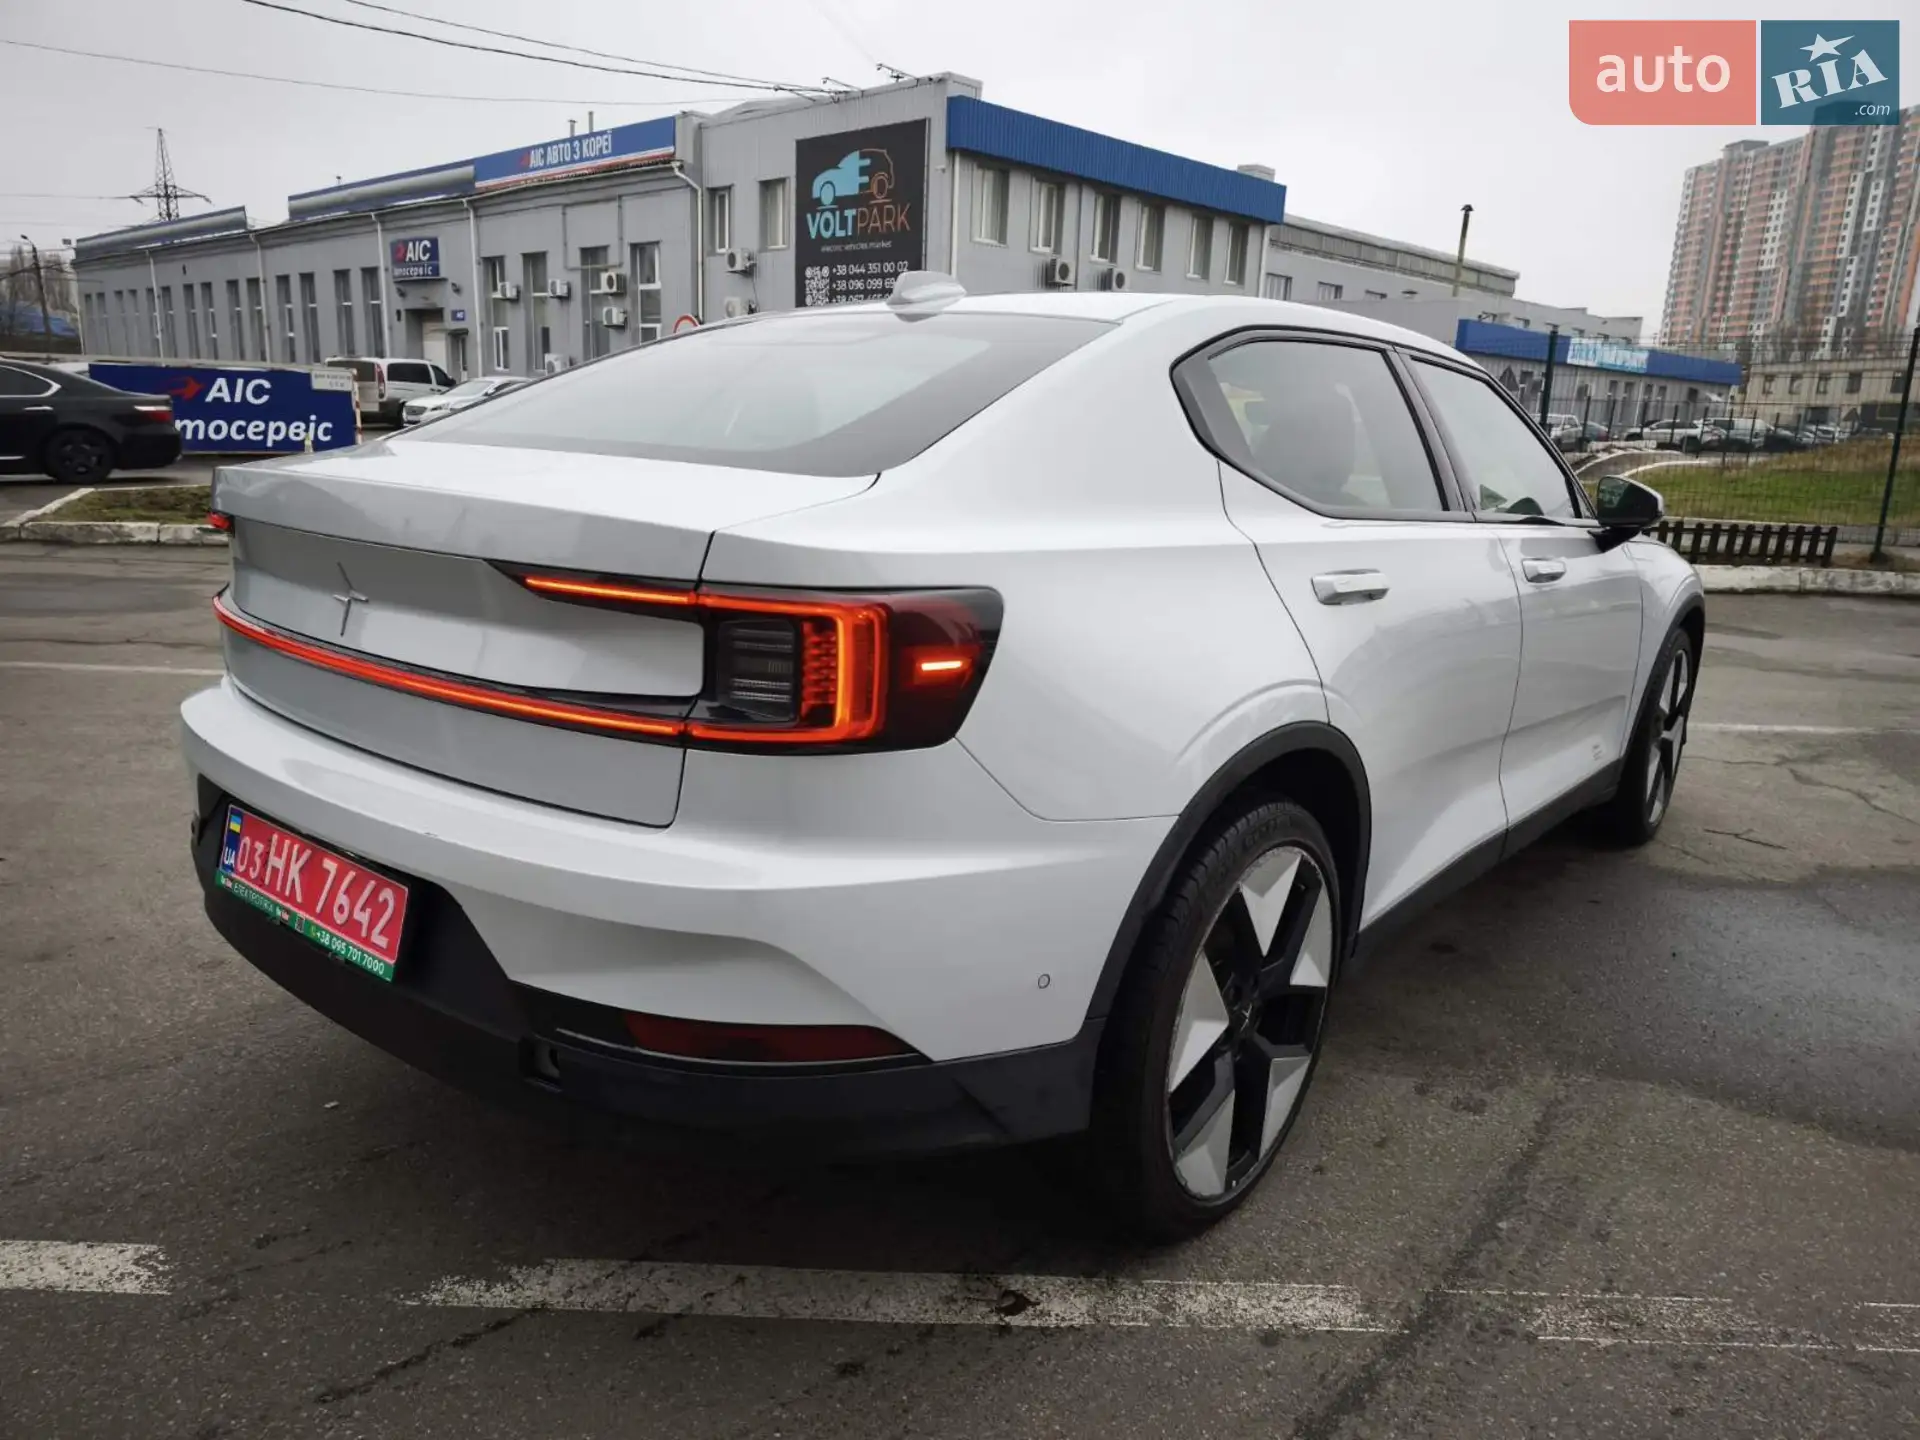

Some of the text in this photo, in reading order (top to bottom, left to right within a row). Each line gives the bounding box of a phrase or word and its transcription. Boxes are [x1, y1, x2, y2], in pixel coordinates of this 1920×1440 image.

[546, 142, 571, 165] АВТО
[582, 130, 613, 158] КОРЕЇ
[832, 260, 909, 276] +38 044 351 00 02
[832, 279, 847, 291] +38
[848, 279, 865, 290] 096
[866, 278, 883, 290] 099
[175, 415, 333, 447] тосервіс
[223, 847, 236, 867] UA
[316, 857, 396, 949] 7642
[316, 930, 385, 976] +38 095 701 7000
